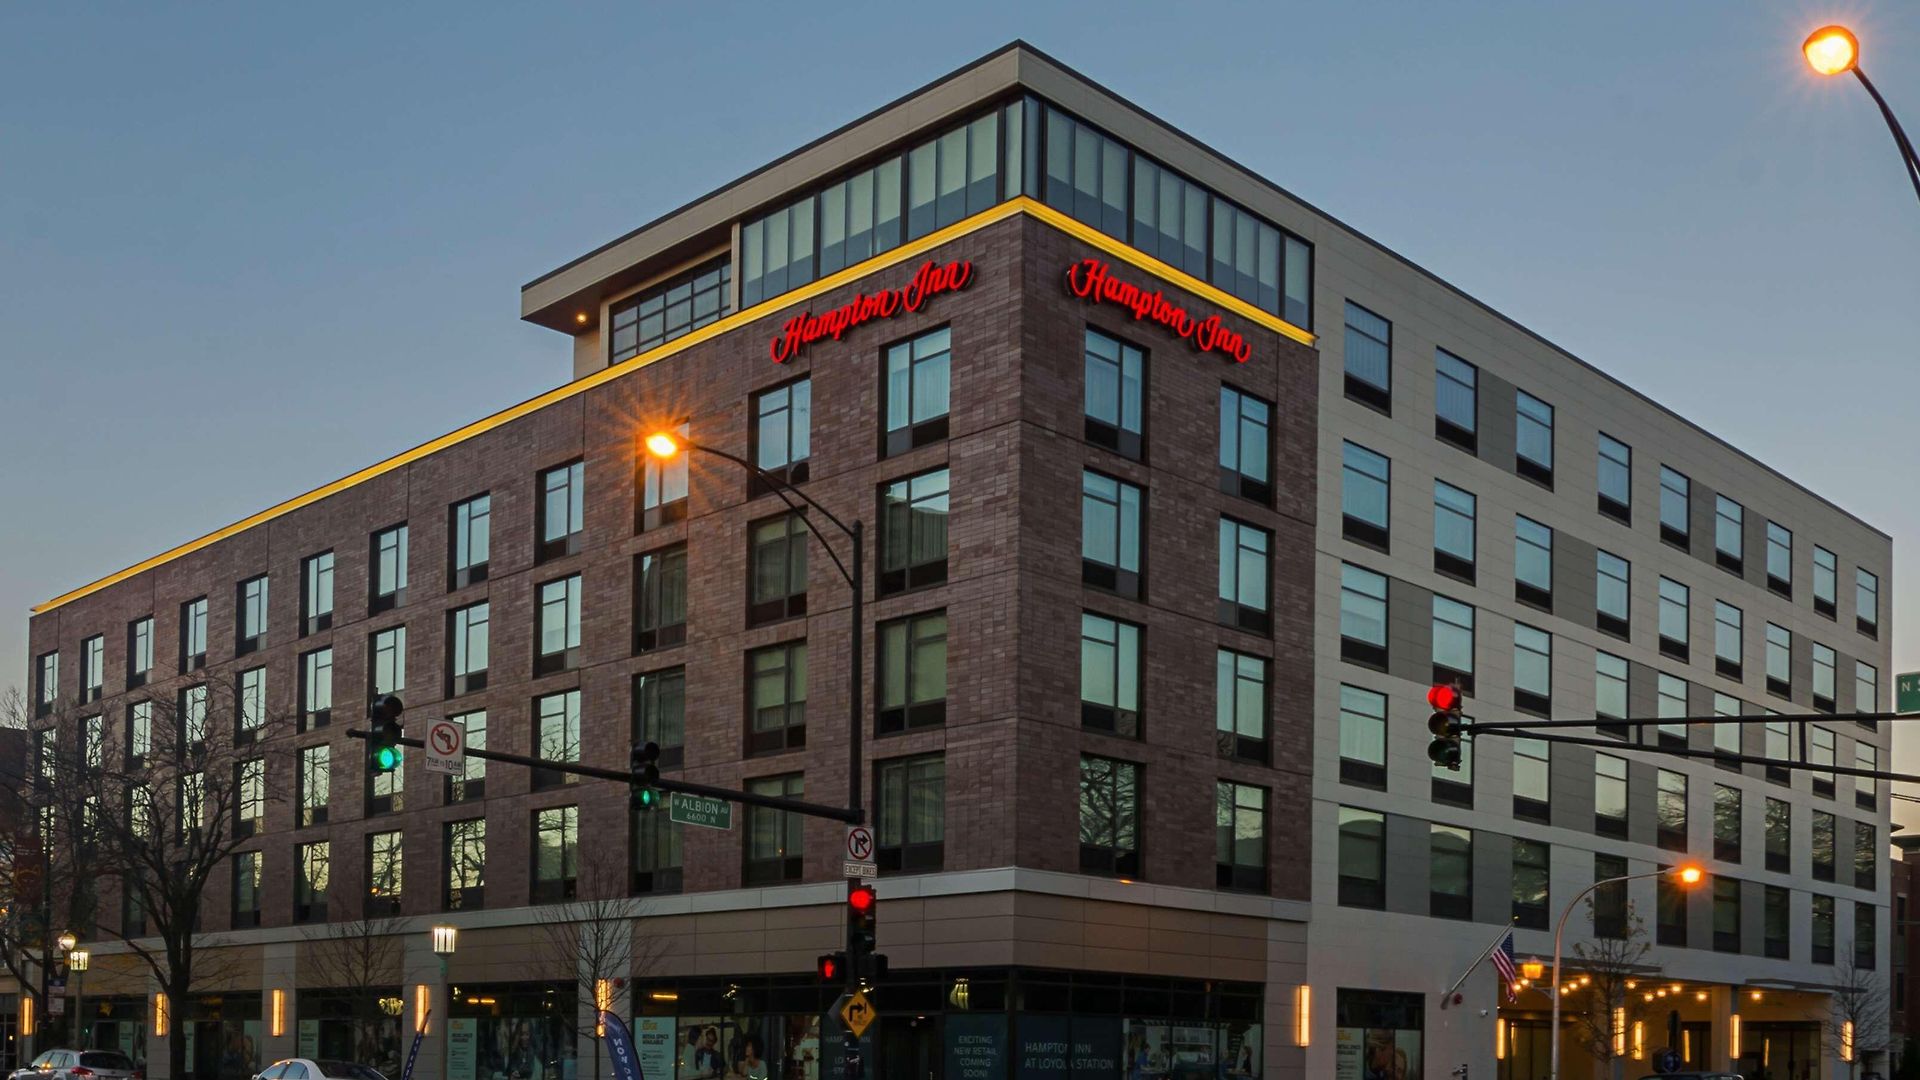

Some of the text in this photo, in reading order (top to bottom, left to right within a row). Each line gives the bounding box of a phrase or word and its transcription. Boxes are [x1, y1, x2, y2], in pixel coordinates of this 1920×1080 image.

[769, 260, 970, 364] Hampton Inn
[1069, 258, 1251, 363] Hampton Inn
[1902, 681, 1911, 692] N
[674, 798, 729, 815] W ALBION AV
[686, 812, 716, 824] 6600 N
[958, 1035, 993, 1044] EXCITING
[953, 1047, 997, 1056] NEW RETAIL
[1075, 1042, 1092, 1054] INN
[959, 1057, 992, 1067] COMING
[1024, 1058, 1037, 1069] AT
[1076, 1058, 1114, 1070] STATION
